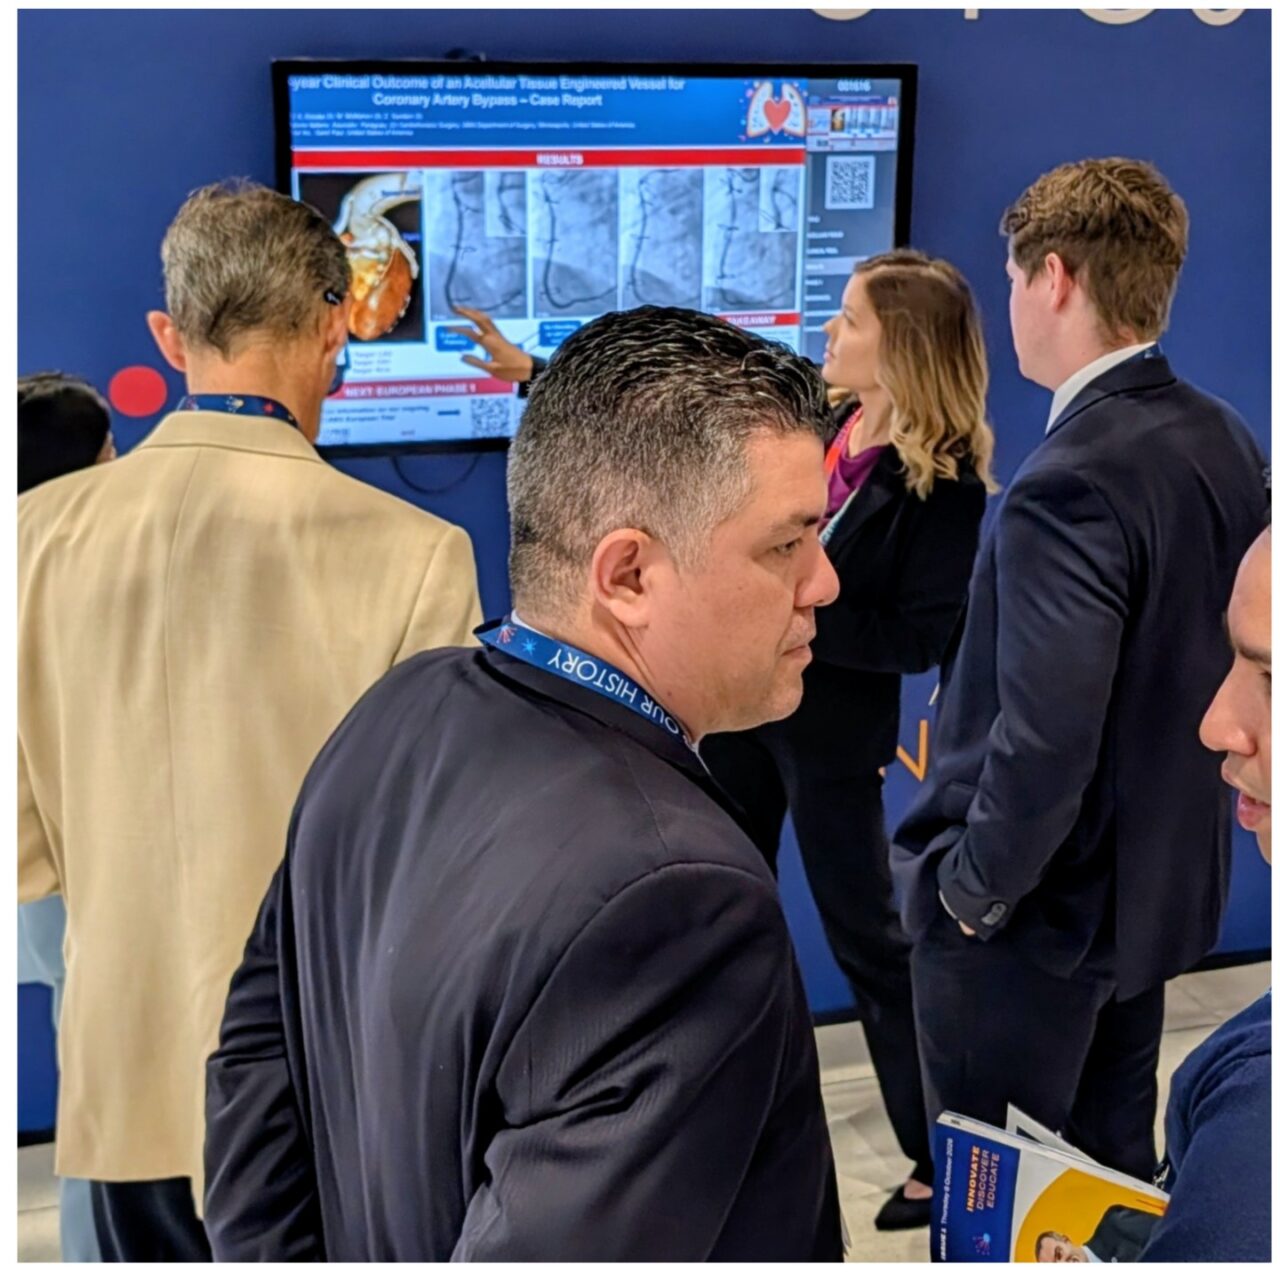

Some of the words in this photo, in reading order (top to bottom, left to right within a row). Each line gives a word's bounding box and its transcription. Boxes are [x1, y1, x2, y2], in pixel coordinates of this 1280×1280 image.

[323, 76, 369, 89] Clinical
[372, 77, 428, 89] Outcome
[430, 76, 443, 89] of
[519, 77, 556, 90] Tissue
[560, 78, 627, 92] Engineered
[630, 79, 667, 91] Vessel
[668, 78, 685, 91] for
[372, 93, 429, 109] Coronary
[433, 93, 469, 109] Artery
[472, 93, 518, 108] Bypass
[530, 94, 559, 107] Case
[561, 93, 602, 108] Report
[547, 649, 638, 704] HISTORY
[966, 1145, 980, 1212] INNOVATE
[976, 1149, 989, 1211] DISCOVER
[987, 1152, 1000, 1208] EDUCATE
